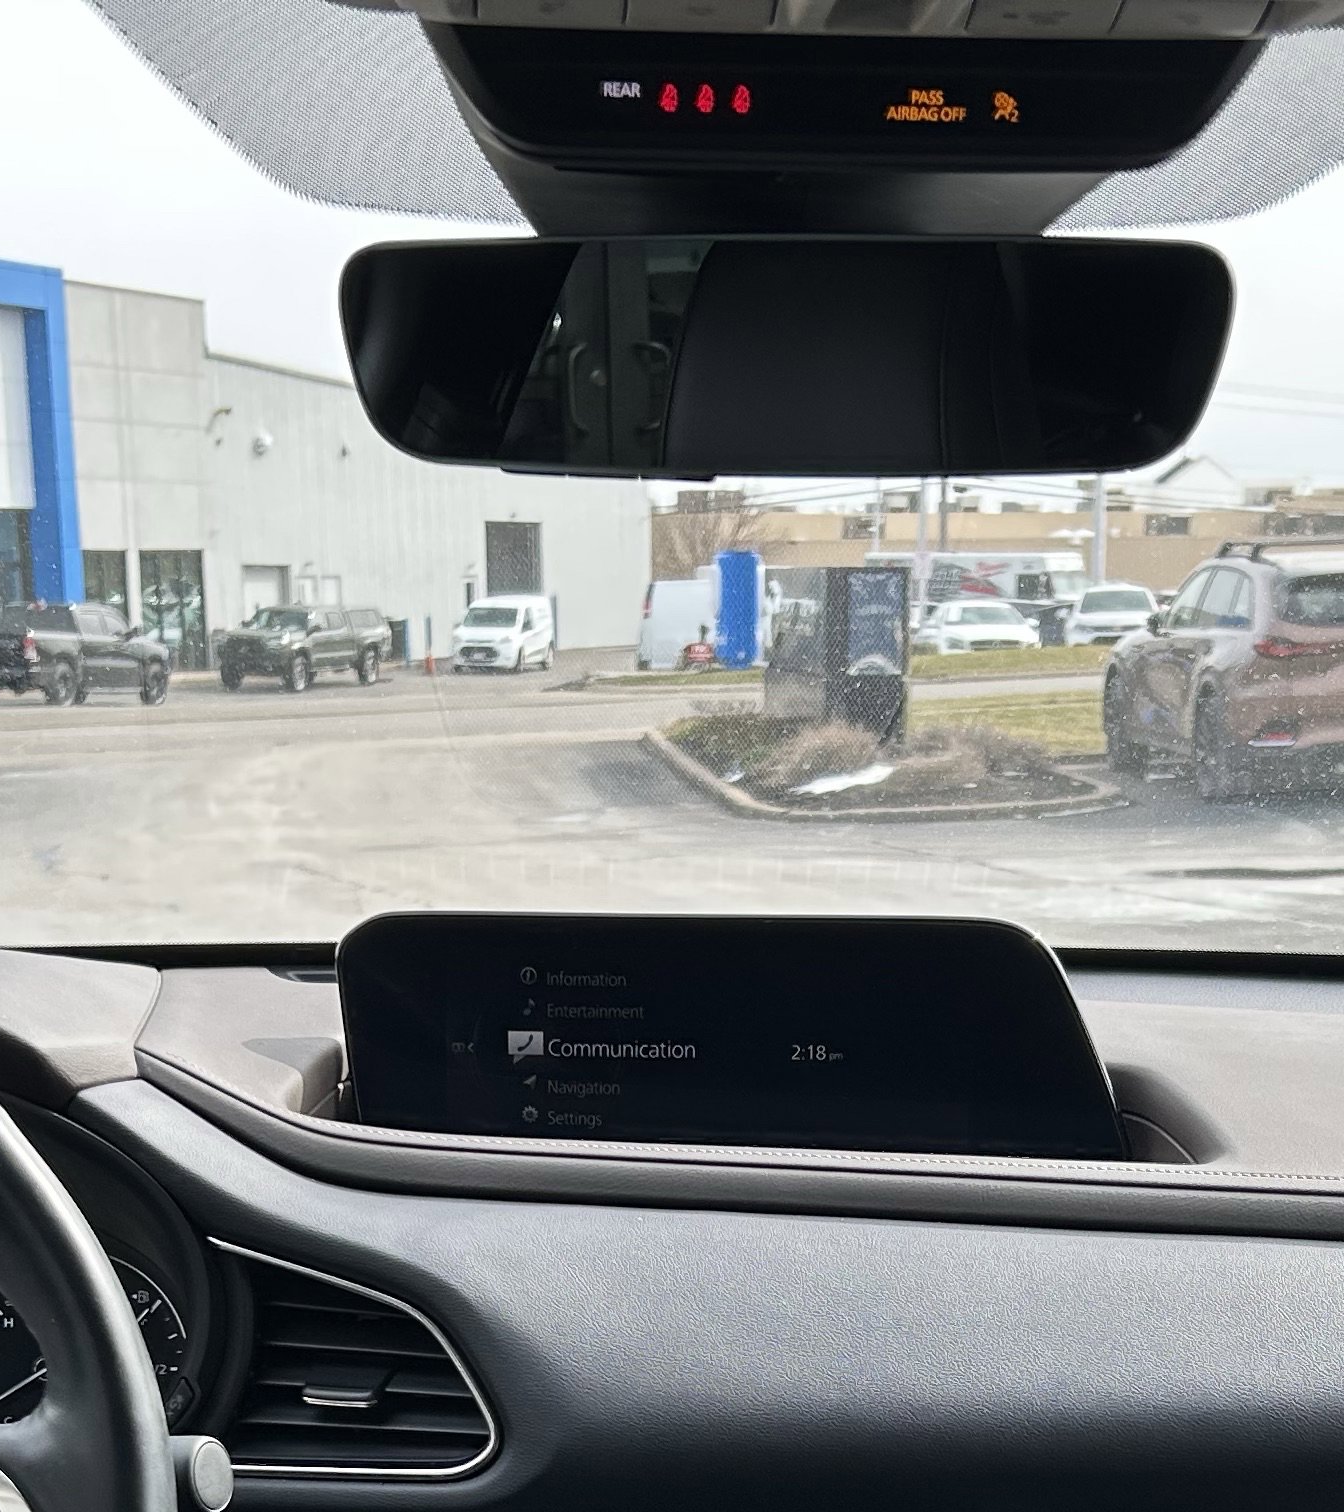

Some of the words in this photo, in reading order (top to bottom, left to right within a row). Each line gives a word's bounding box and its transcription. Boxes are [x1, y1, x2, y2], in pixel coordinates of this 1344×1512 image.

[602, 82, 641, 98] REAR
[911, 89, 944, 106] PASS
[886, 106, 940, 121] AIRBAG
[940, 106, 967, 121] OFF
[546, 971, 627, 988] Information
[546, 1003, 644, 1021] Entertainment
[548, 1039, 697, 1060] Communication
[791, 1044, 827, 1062] 2:18
[547, 1080, 621, 1097] Navigation
[547, 1110, 603, 1128] Settings
[3, 1317, 14, 1328] H
